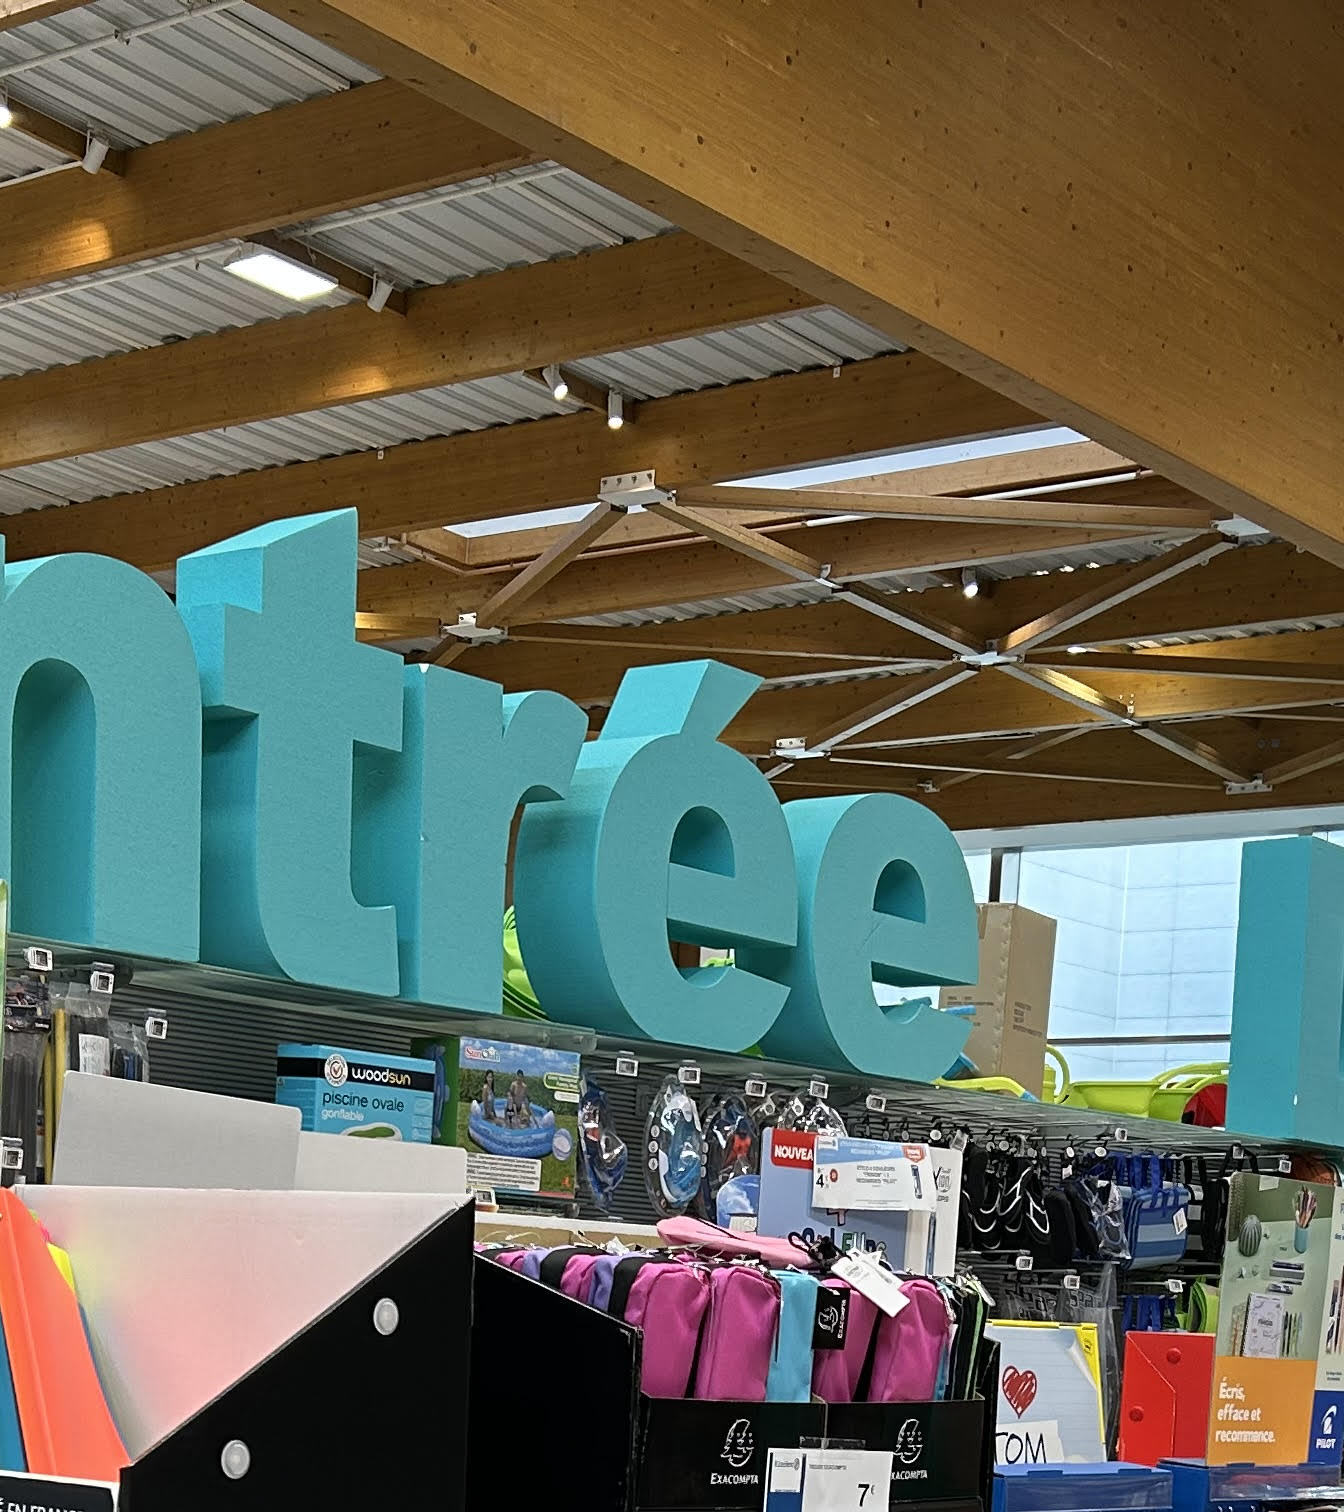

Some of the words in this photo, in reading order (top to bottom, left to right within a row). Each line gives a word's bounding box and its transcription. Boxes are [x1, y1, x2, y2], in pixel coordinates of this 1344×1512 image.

[351, 1066, 412, 1087] woodsun
[322, 1090, 369, 1110] piscine
[371, 1098, 405, 1113] ovale
[321, 1108, 365, 1123] gonflable
[815, 1173, 825, 1189] 4
[1217, 1403, 1249, 1423] efface
[1250, 1406, 1262, 1422] et
[1315, 1438, 1337, 1449] PILOT
[710, 1472, 760, 1487] EXACOMPTA
[857, 1484, 870, 1507] 7
